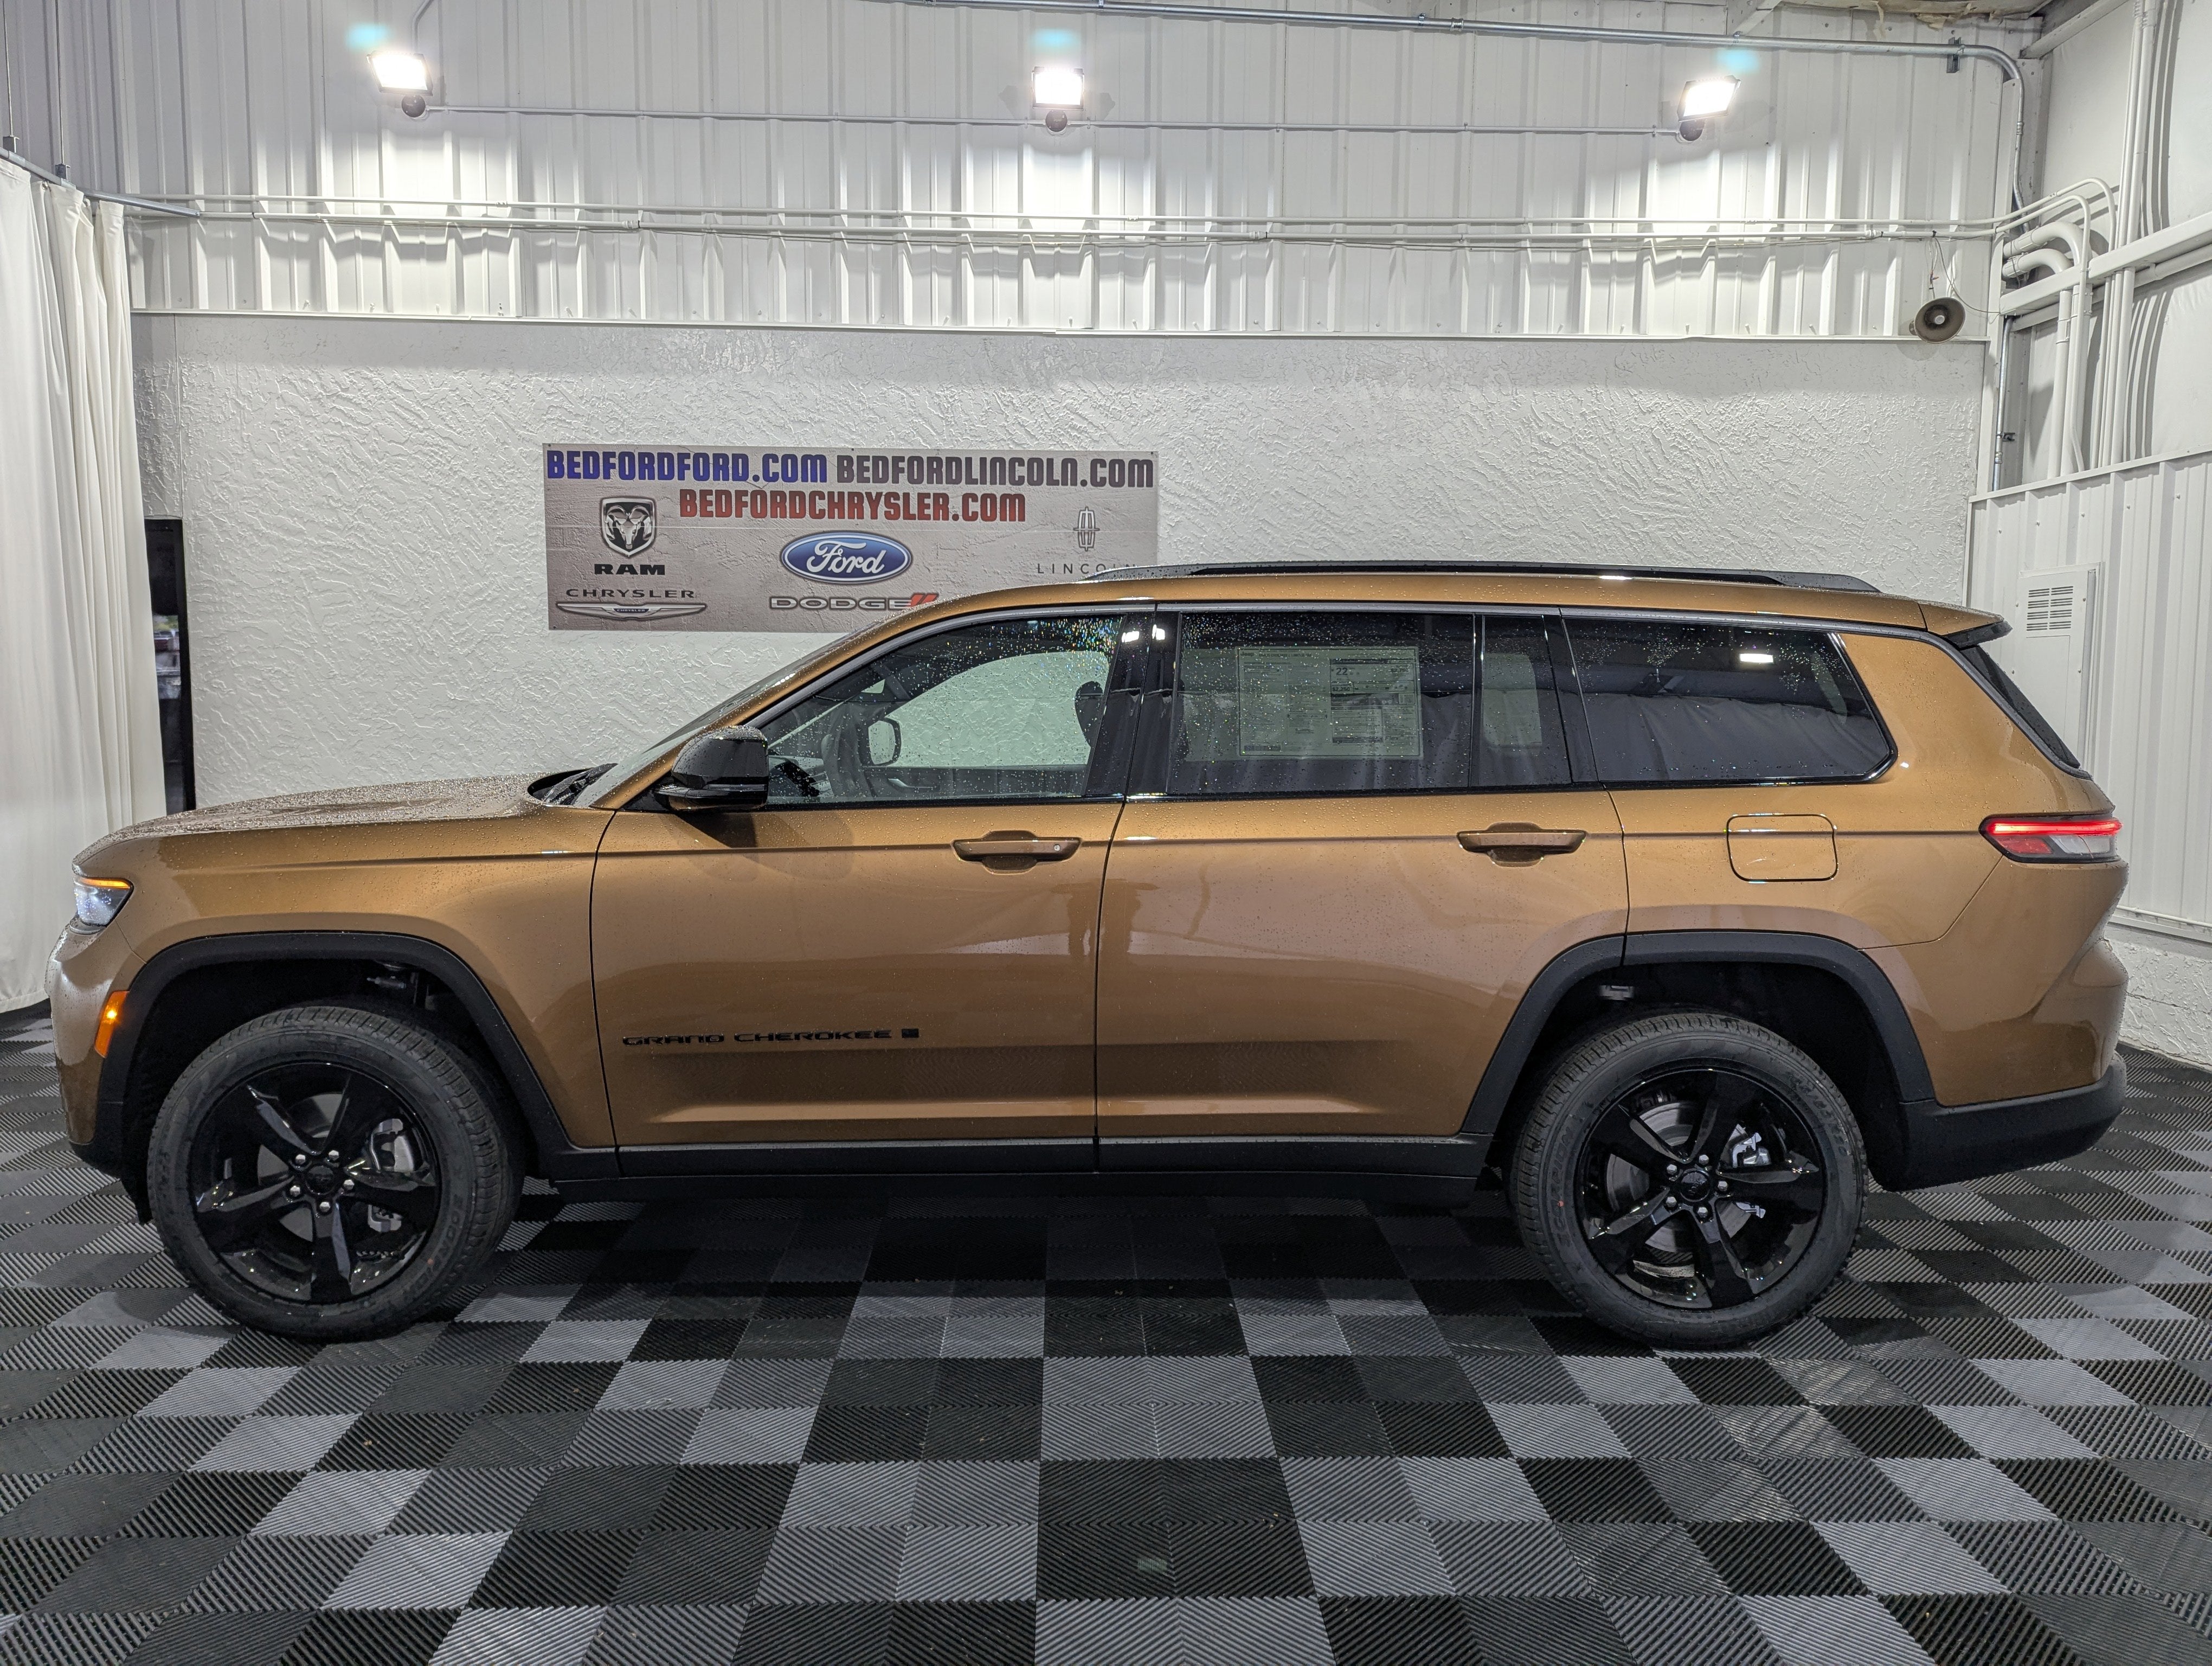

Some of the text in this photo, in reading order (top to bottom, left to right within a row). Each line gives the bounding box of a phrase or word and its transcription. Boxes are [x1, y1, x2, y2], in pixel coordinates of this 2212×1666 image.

[547, 450, 1153, 488] BEDFORDFORD.COM BEDFORDLINCOLN.COM
[680, 489, 1026, 522] BEDFORDCHRYSLER.COM
[806, 540, 886, 573] Ford
[594, 564, 665, 575] RAM
[1037, 563, 1135, 574] LINCO
[566, 588, 695, 598] CHRYSLER
[770, 597, 911, 610] DODGE
[1336, 667, 1348, 676] 22
[623, 1033, 724, 1046] GRAND
[734, 1030, 892, 1042] CHEROKEE
